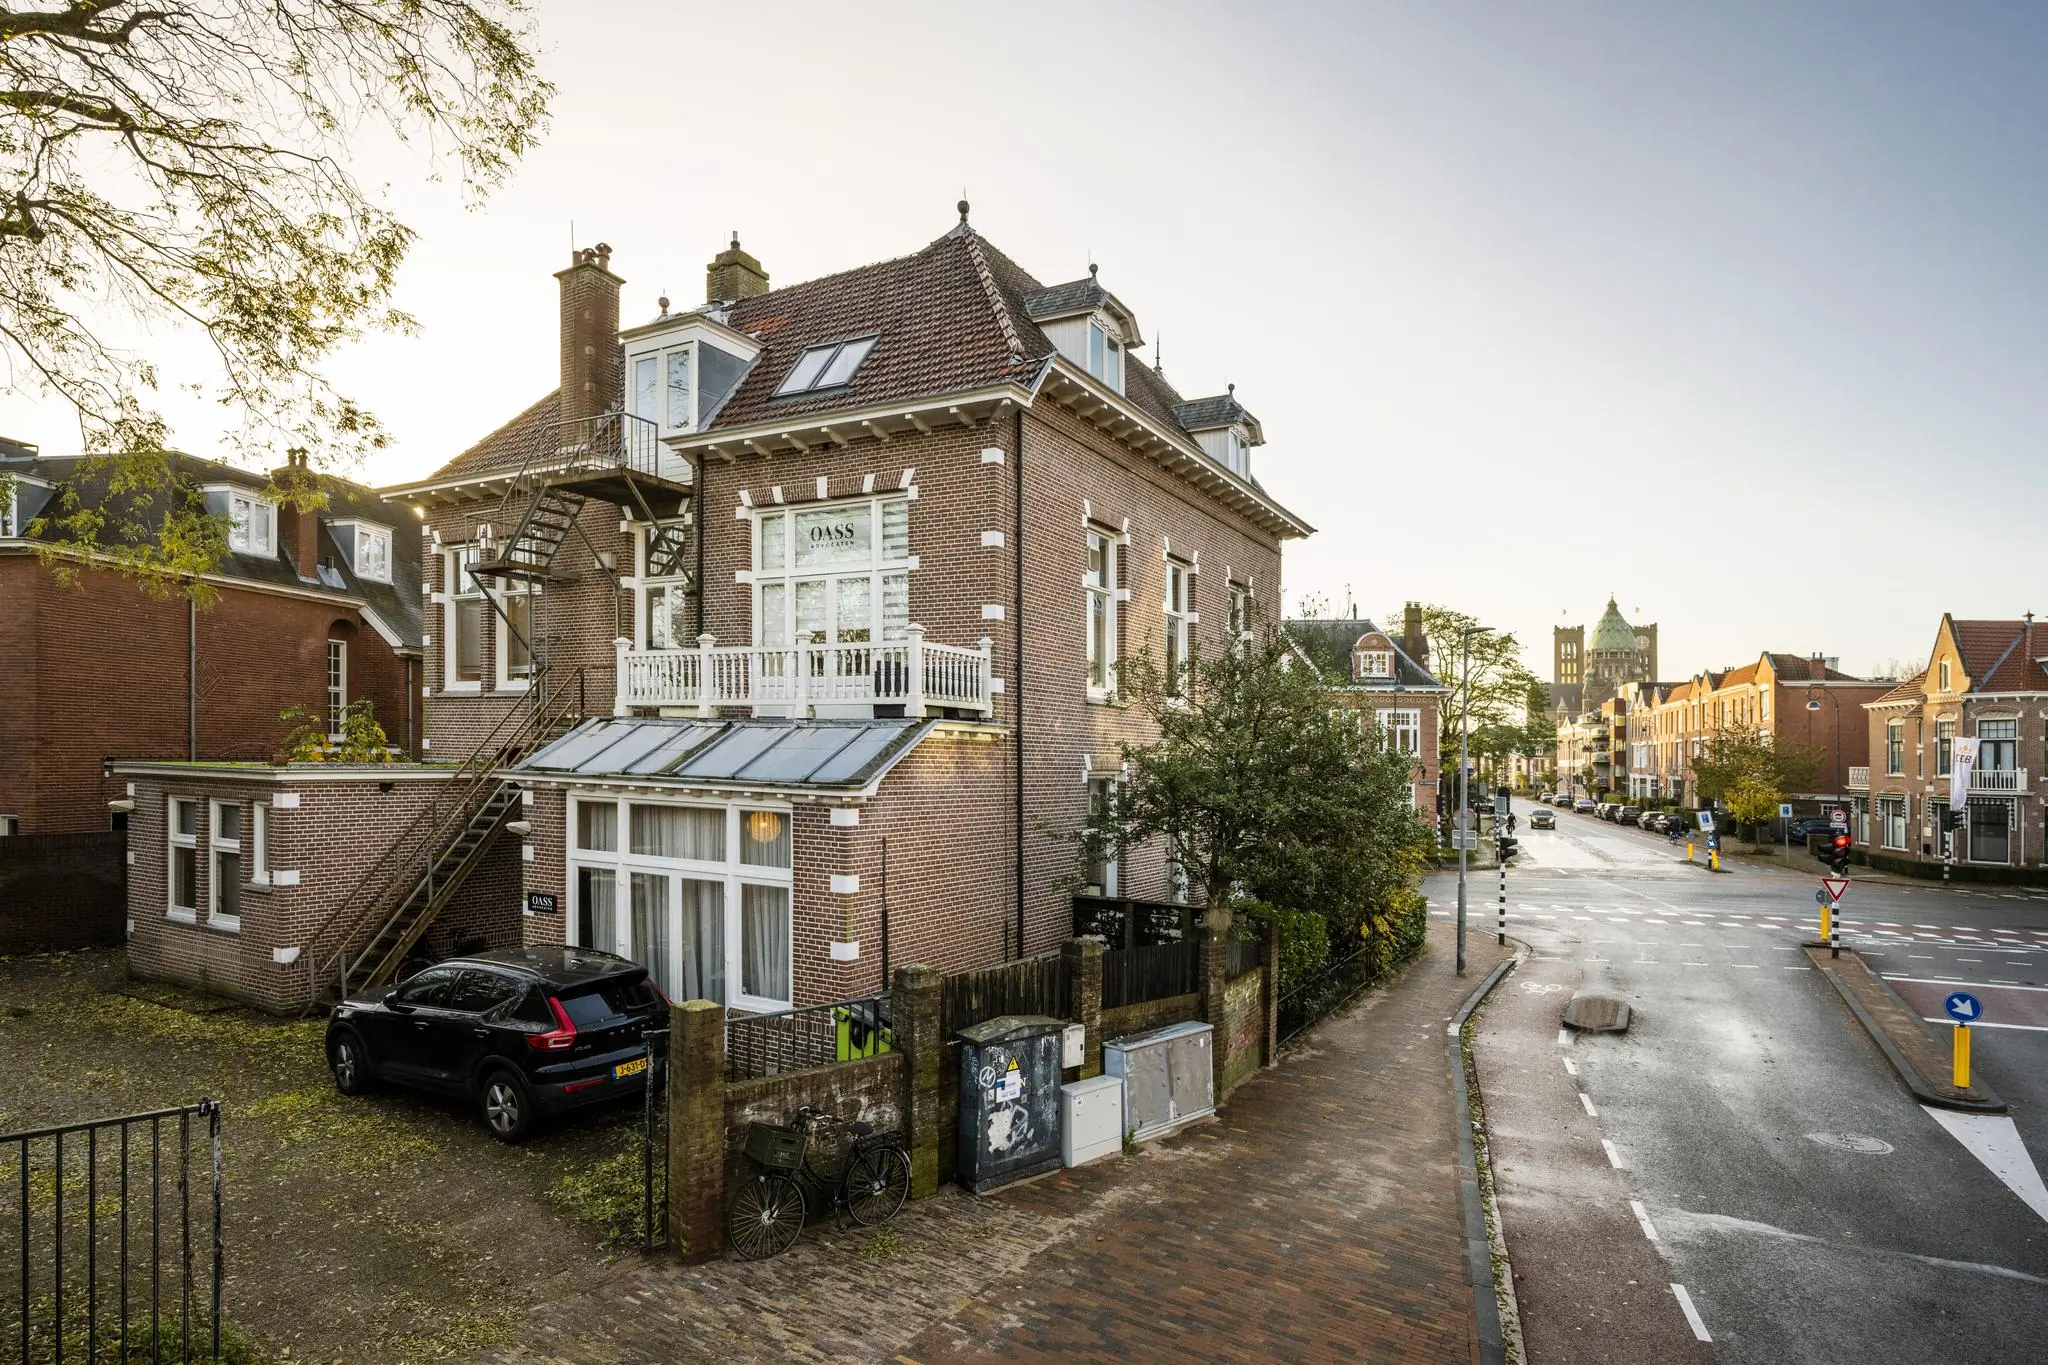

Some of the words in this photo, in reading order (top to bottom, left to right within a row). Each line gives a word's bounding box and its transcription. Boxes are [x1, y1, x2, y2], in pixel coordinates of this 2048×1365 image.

[810, 523, 855, 542] OASS
[811, 540, 855, 549] ADVOCATEN
[532, 895, 553, 907] OASS
